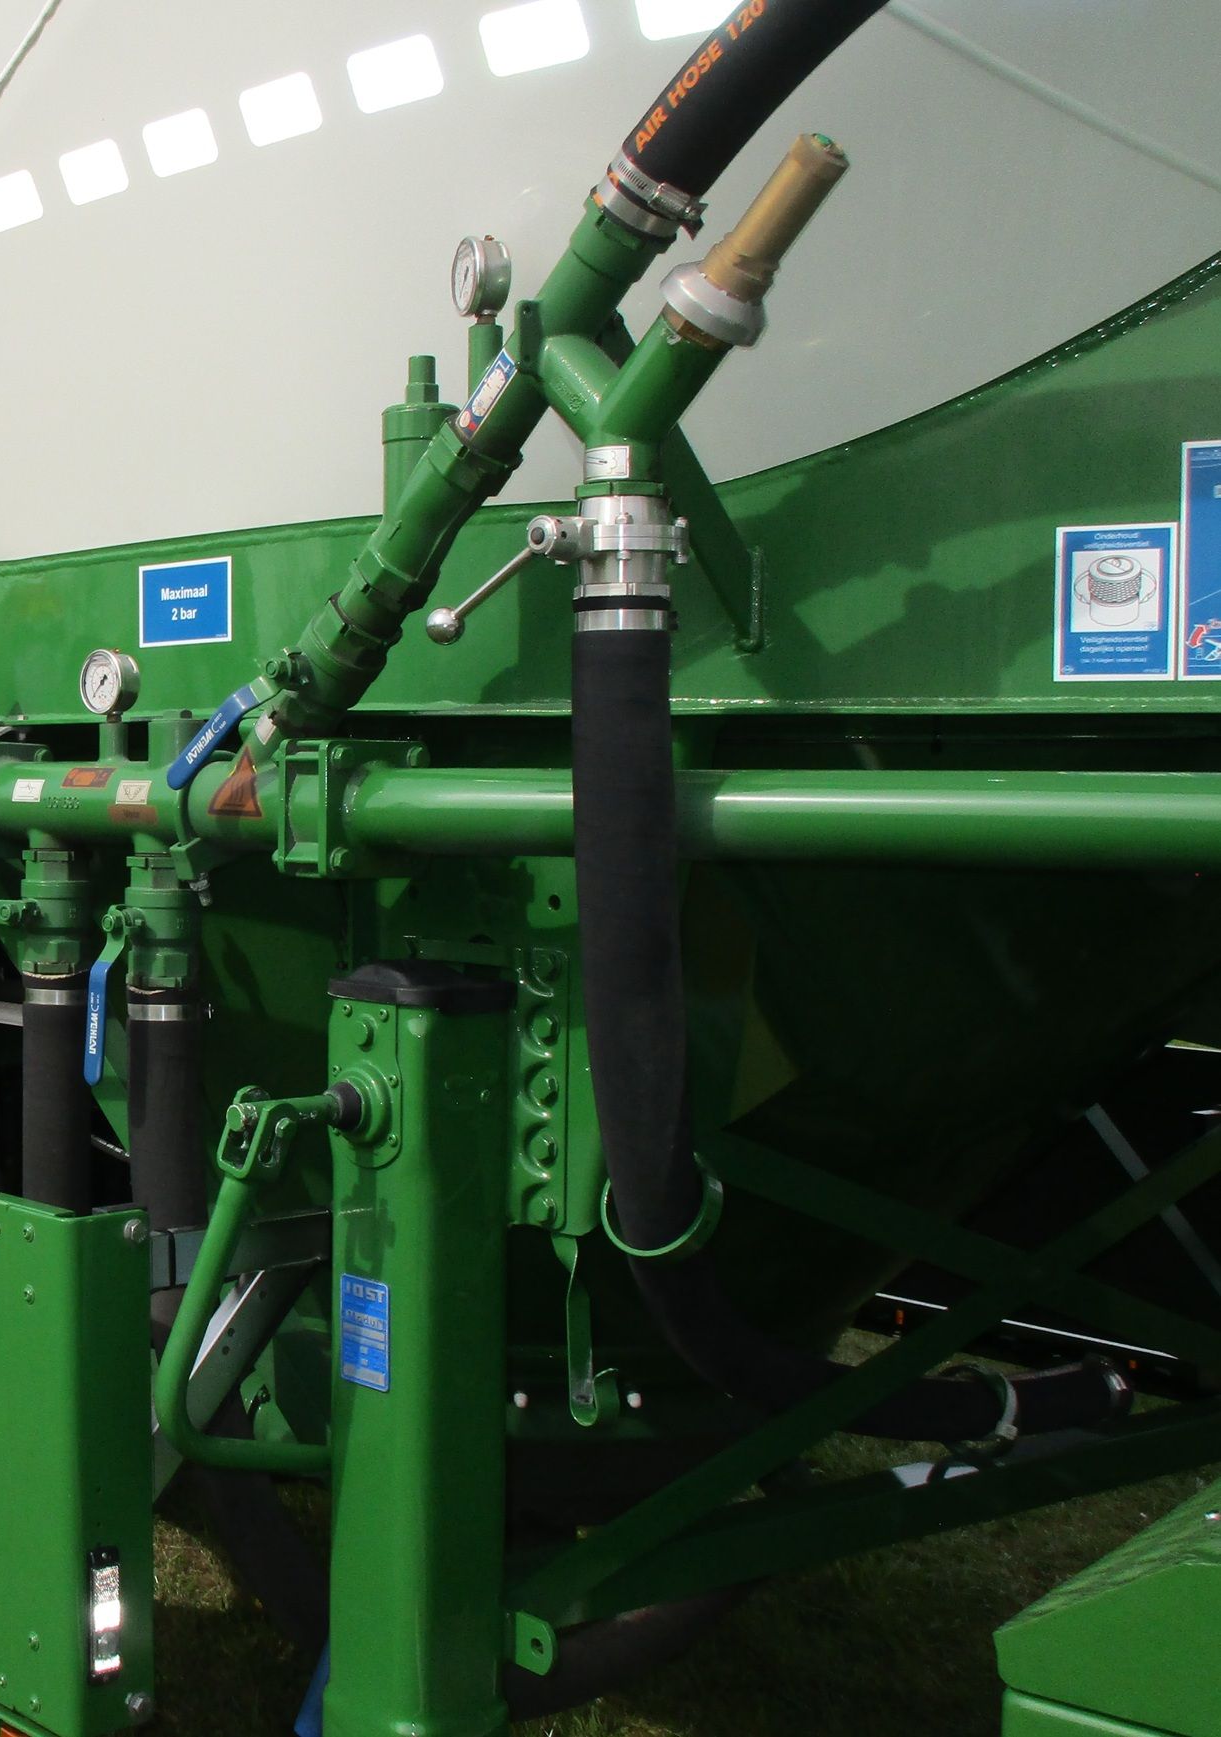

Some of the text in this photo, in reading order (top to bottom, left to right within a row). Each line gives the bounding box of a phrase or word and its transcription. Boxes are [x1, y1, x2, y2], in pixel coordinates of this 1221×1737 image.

[634, 106, 669, 153] AIR
[667, 38, 724, 108] HOSE
[160, 583, 208, 602] Maximaal
[171, 606, 197, 621] 2 bar
